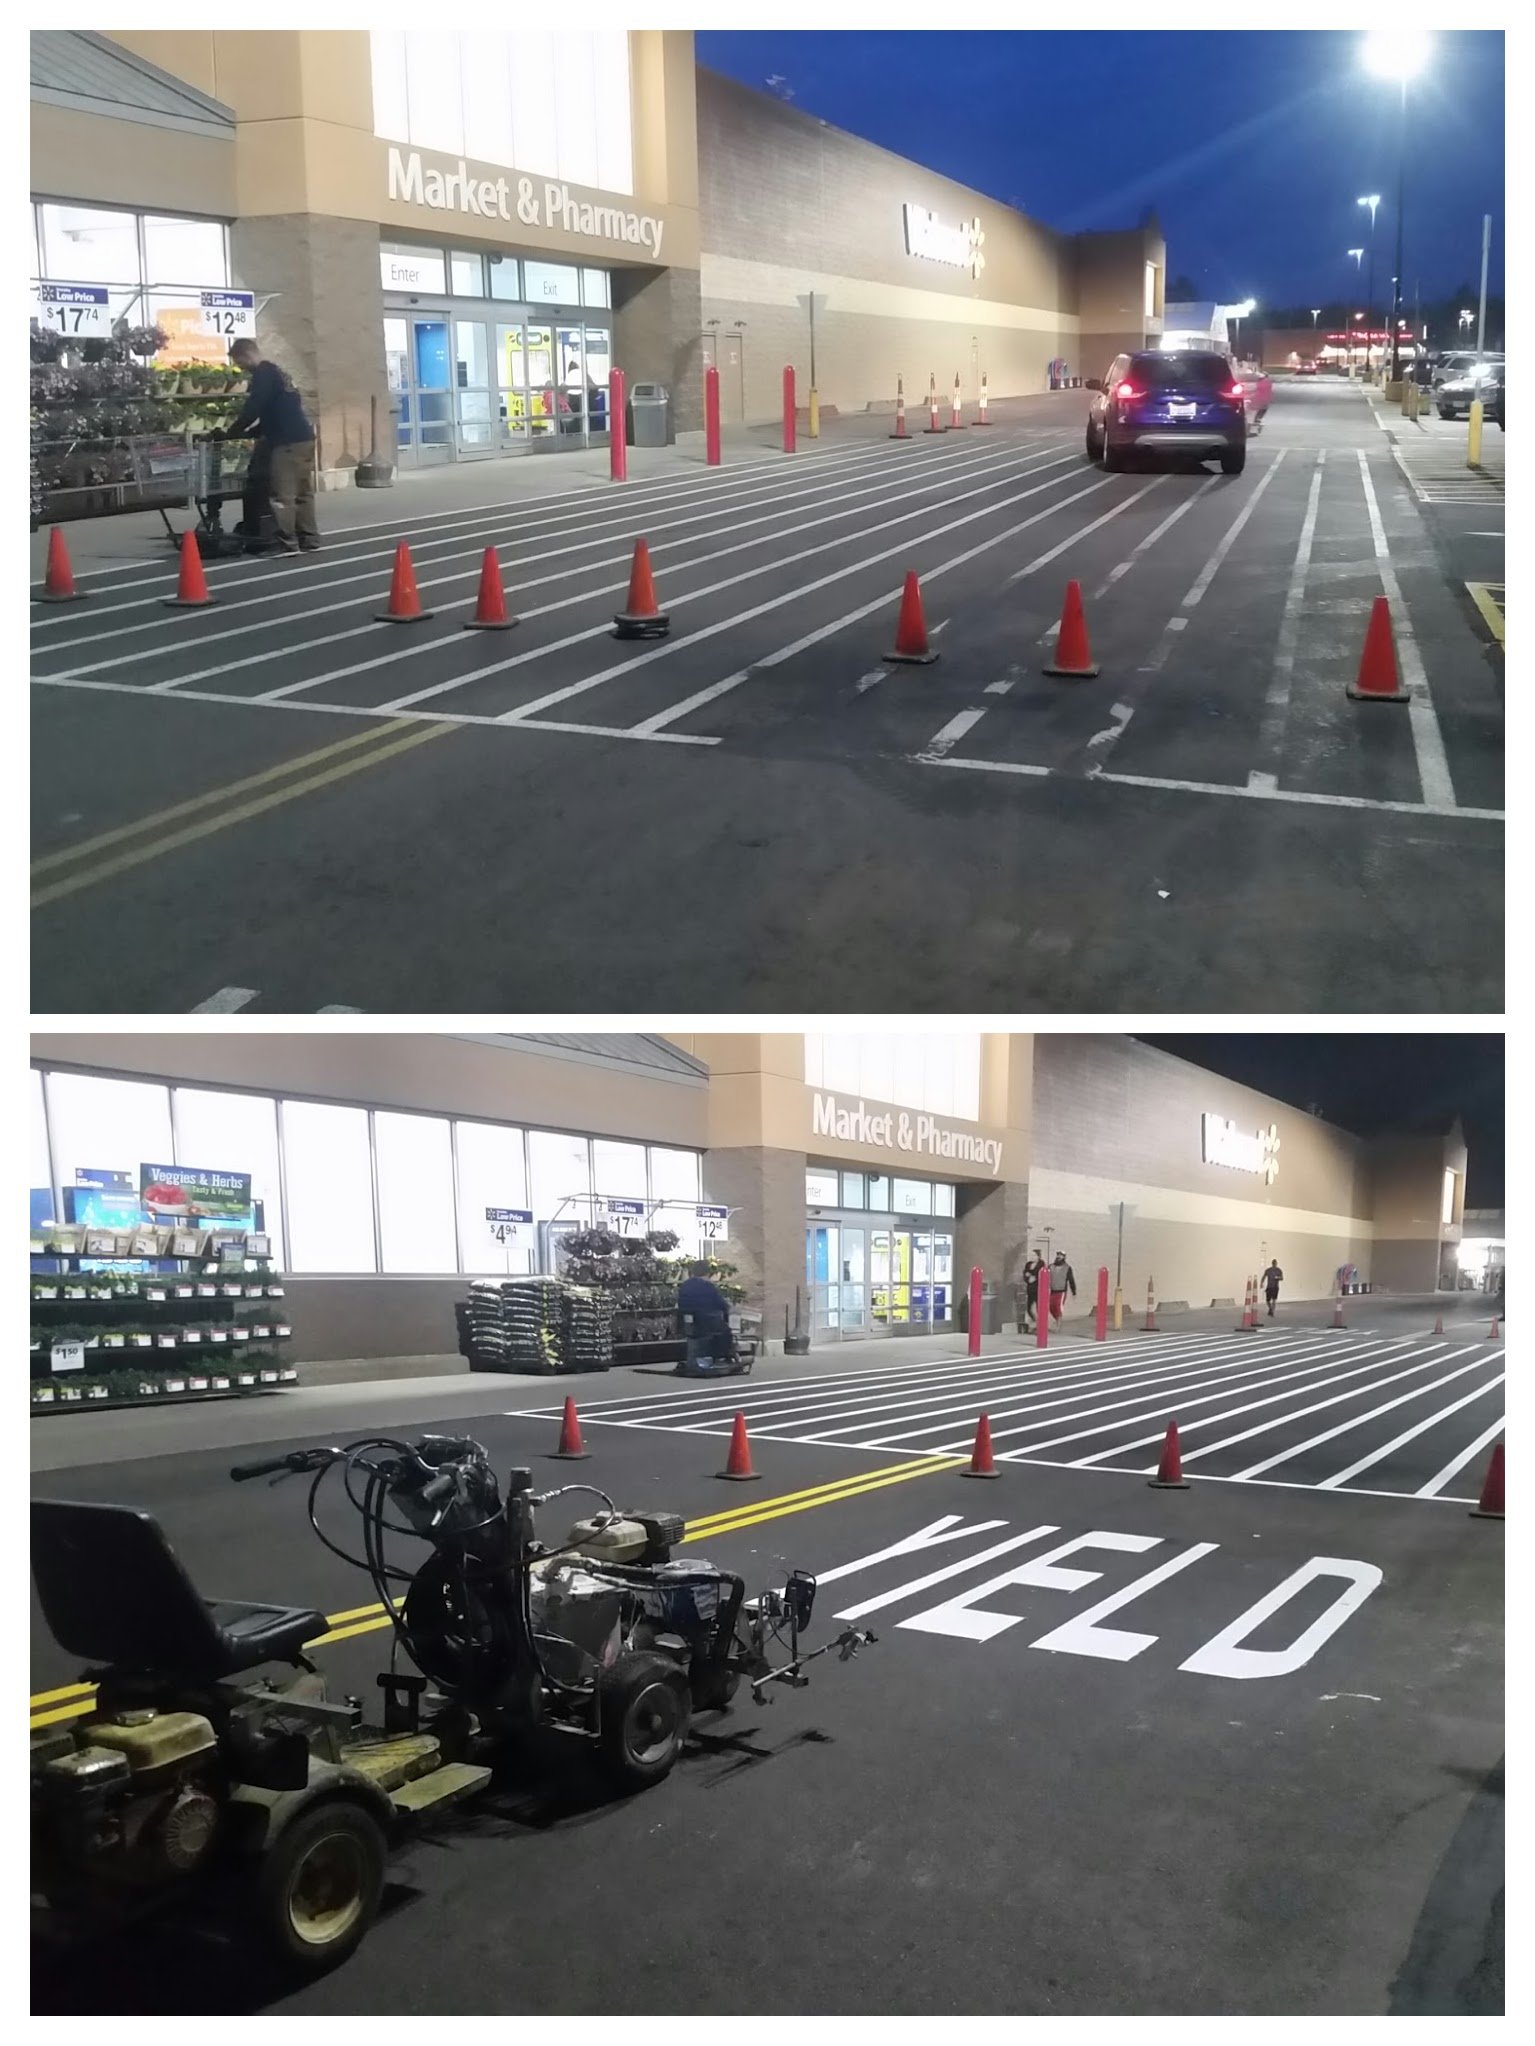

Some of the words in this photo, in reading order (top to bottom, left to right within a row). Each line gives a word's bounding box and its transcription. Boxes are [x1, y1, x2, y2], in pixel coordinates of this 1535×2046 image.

[388, 147, 510, 222] Market
[517, 177, 540, 225] &
[544, 183, 664, 259] Pharmacy
[391, 264, 420, 283] Enter
[56, 290, 74, 301] Low
[74, 291, 96, 303] Price
[543, 282, 558, 297] Exit
[813, 1093, 893, 1148] Market
[898, 1112, 914, 1151] &
[917, 1116, 1003, 1175] Pharmacy
[151, 1168, 197, 1186] Veggies
[199, 1172, 209, 1185] &
[212, 1175, 243, 1189] Herbs
[807, 1187, 822, 1199] nter
[744, 1514, 1385, 1680] YIELD
